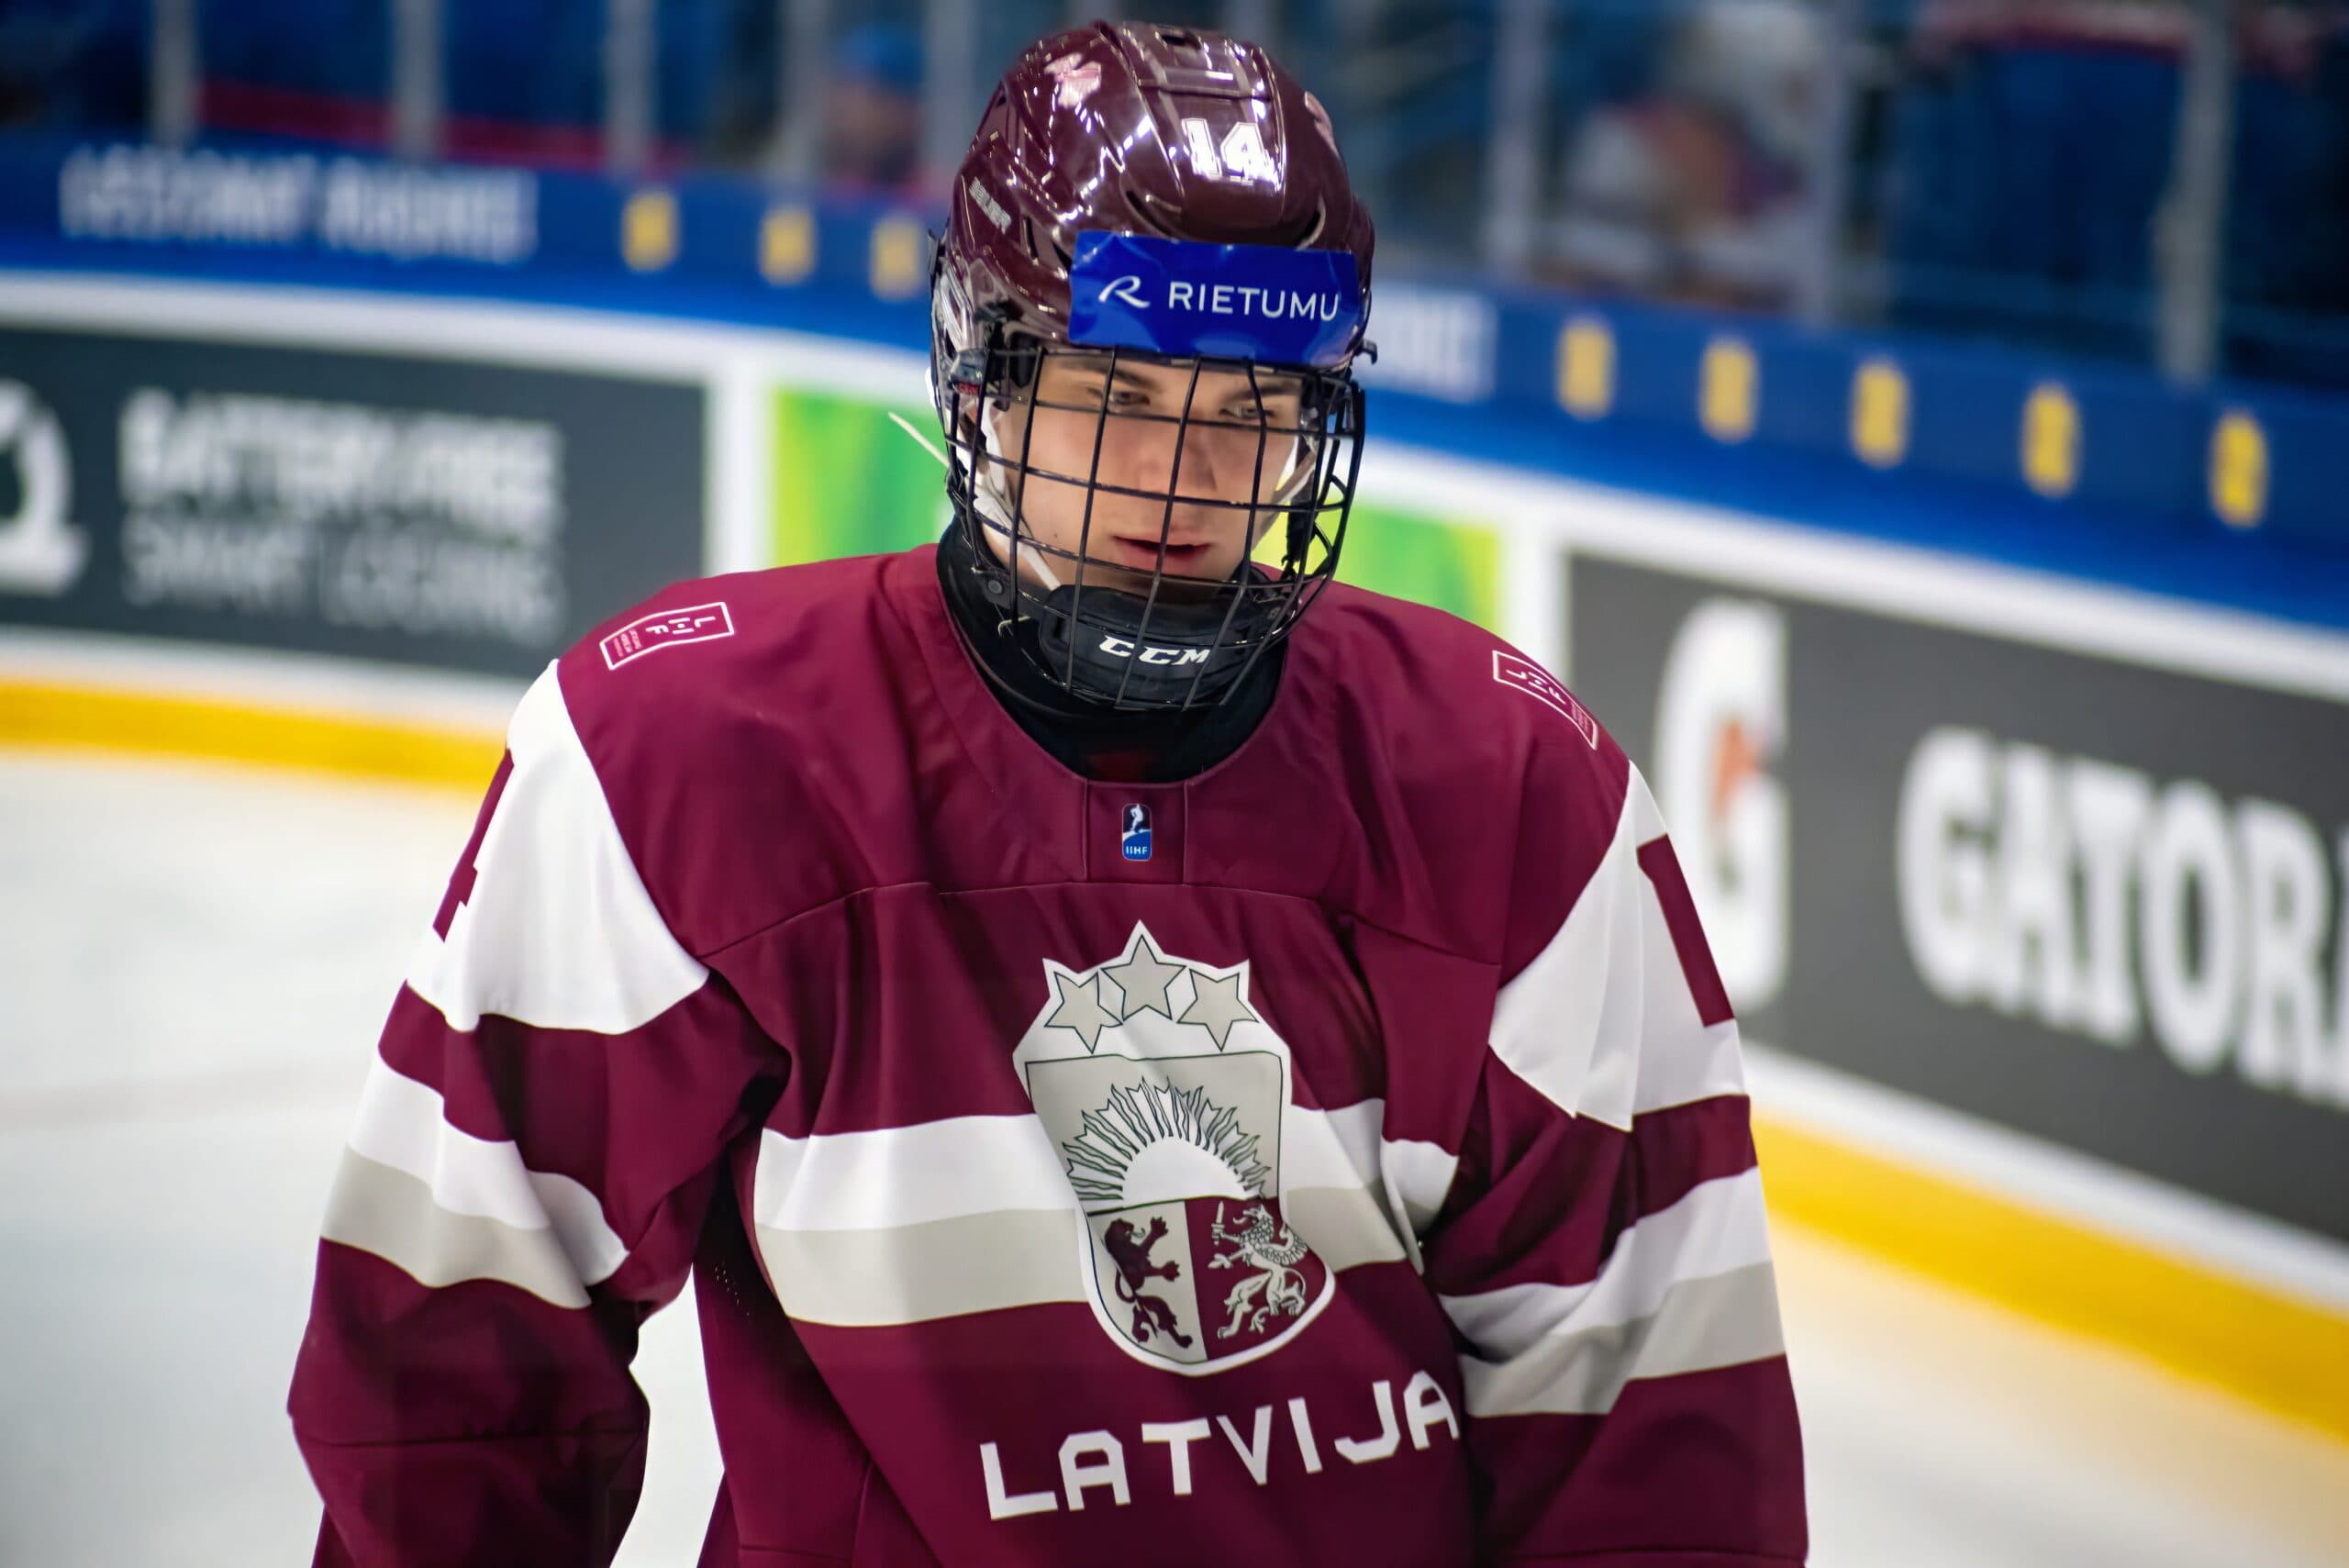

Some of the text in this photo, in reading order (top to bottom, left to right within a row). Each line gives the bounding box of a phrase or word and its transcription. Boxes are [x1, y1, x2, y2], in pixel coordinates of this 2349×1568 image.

[1181, 118, 1277, 186] 14
[1168, 281, 1339, 321] RIETUMU
[1099, 635, 1211, 665] CCM
[1125, 845, 1149, 855] IIHF
[1898, 728, 2349, 1112] GATOR
[979, 1370, 1461, 1521] LATVIJA
